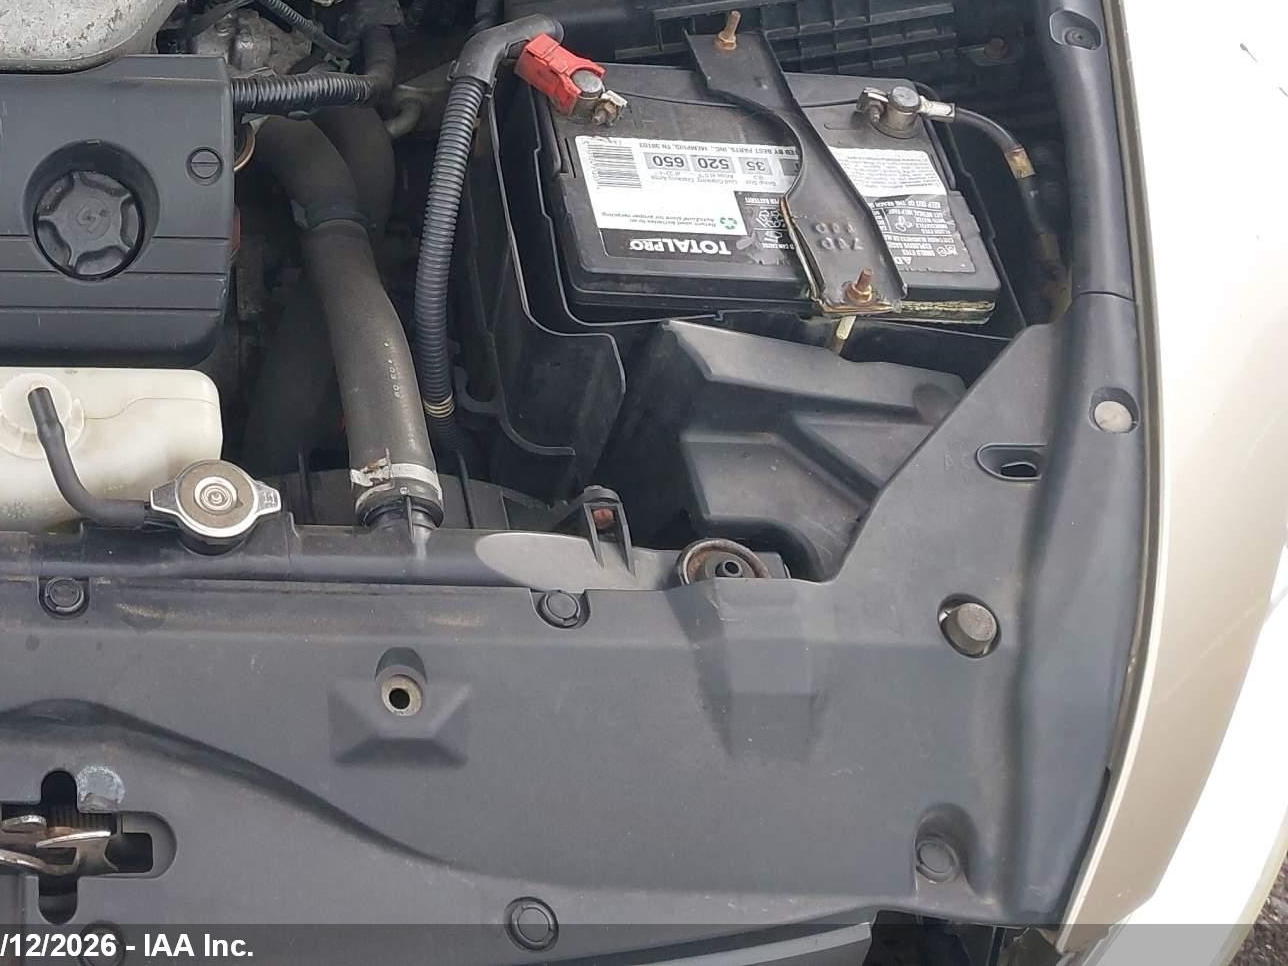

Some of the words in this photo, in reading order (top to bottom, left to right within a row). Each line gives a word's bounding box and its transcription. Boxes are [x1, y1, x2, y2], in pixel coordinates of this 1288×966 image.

[653, 156, 684, 168] 650
[698, 158, 728, 169] 520
[747, 161, 765, 171] 35
[630, 238, 731, 255] TOTALPRO
